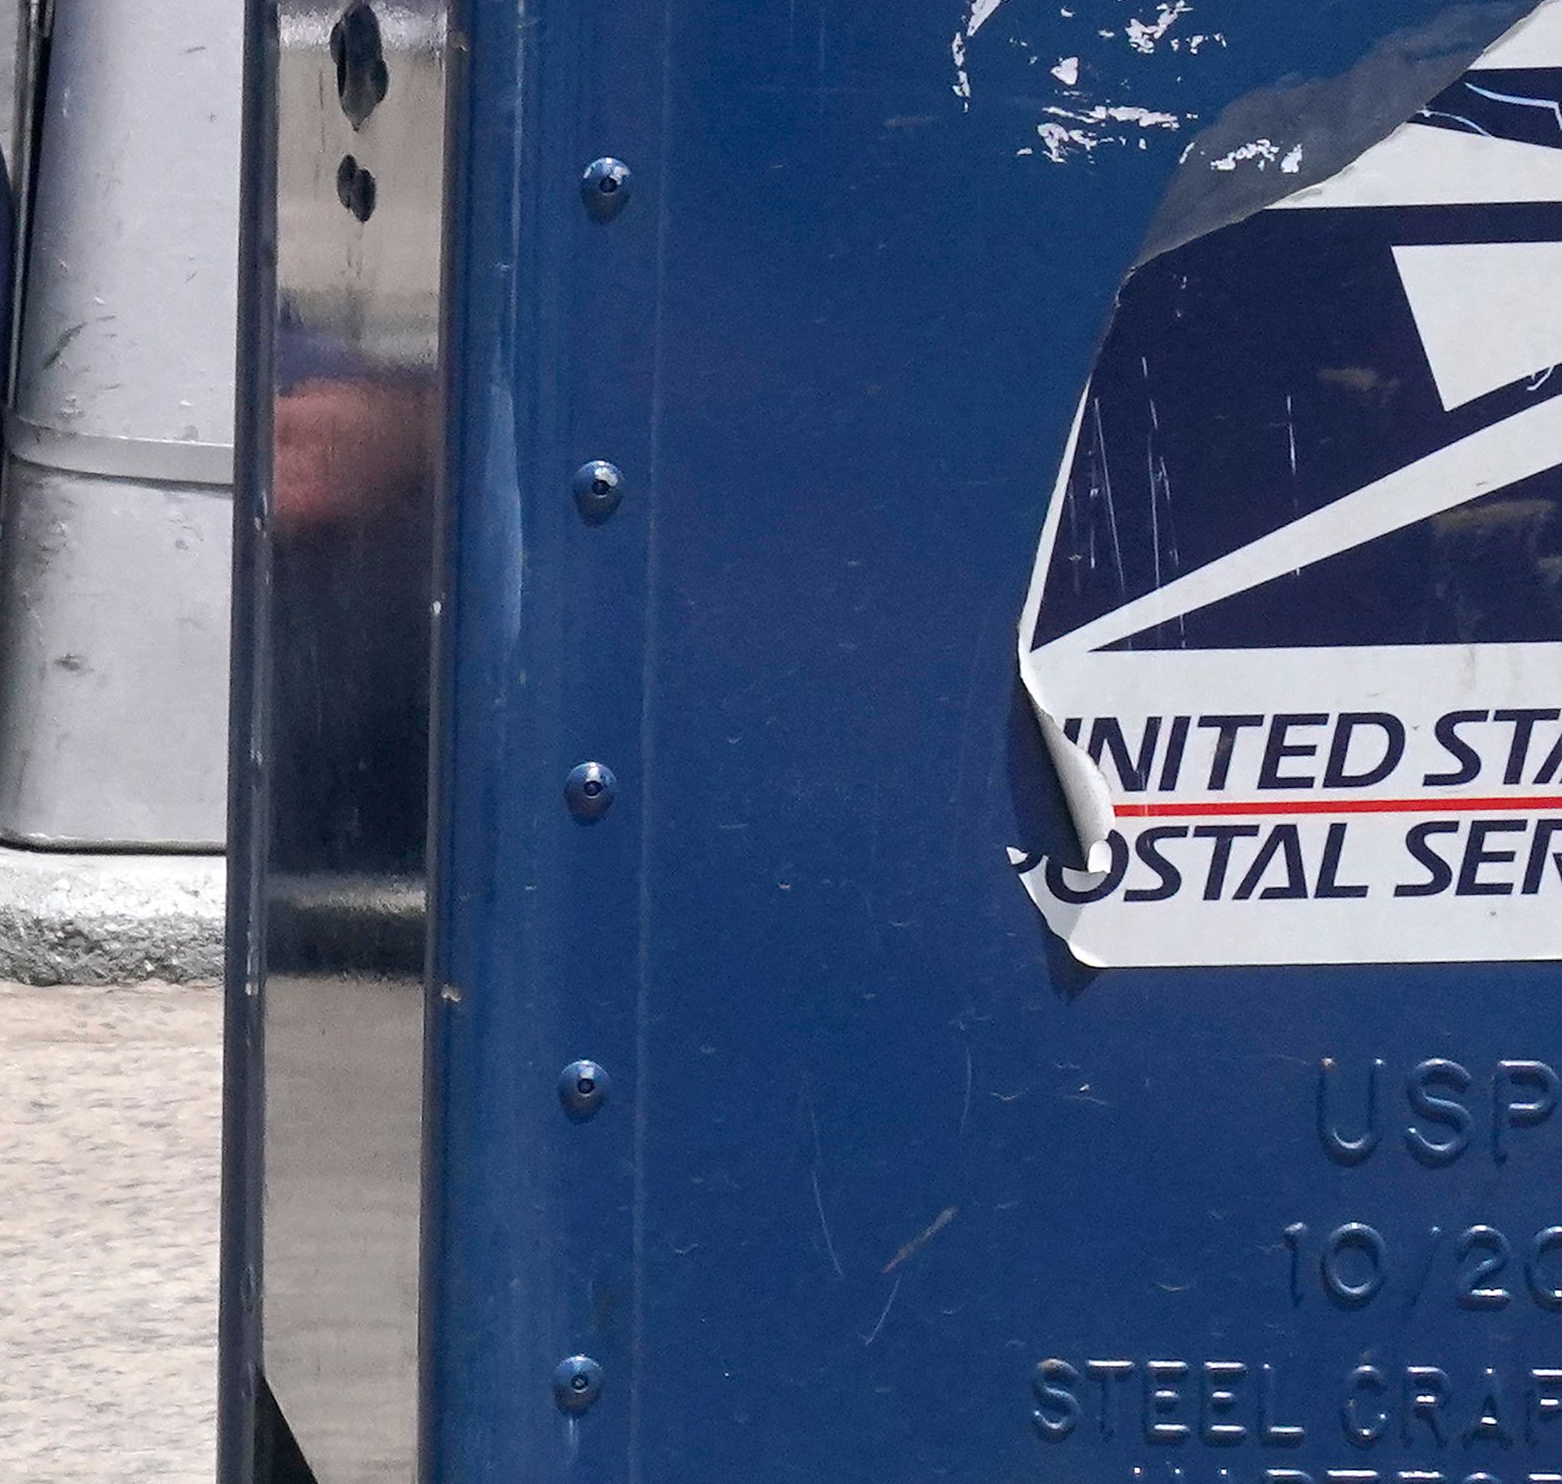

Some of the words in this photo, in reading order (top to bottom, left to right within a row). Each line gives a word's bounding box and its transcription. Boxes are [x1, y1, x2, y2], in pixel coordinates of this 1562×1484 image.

[1010, 822, 1369, 904] OSTAL
[1316, 1057, 1560, 1168] USP
[1032, 1358, 1305, 1447] STEEL
